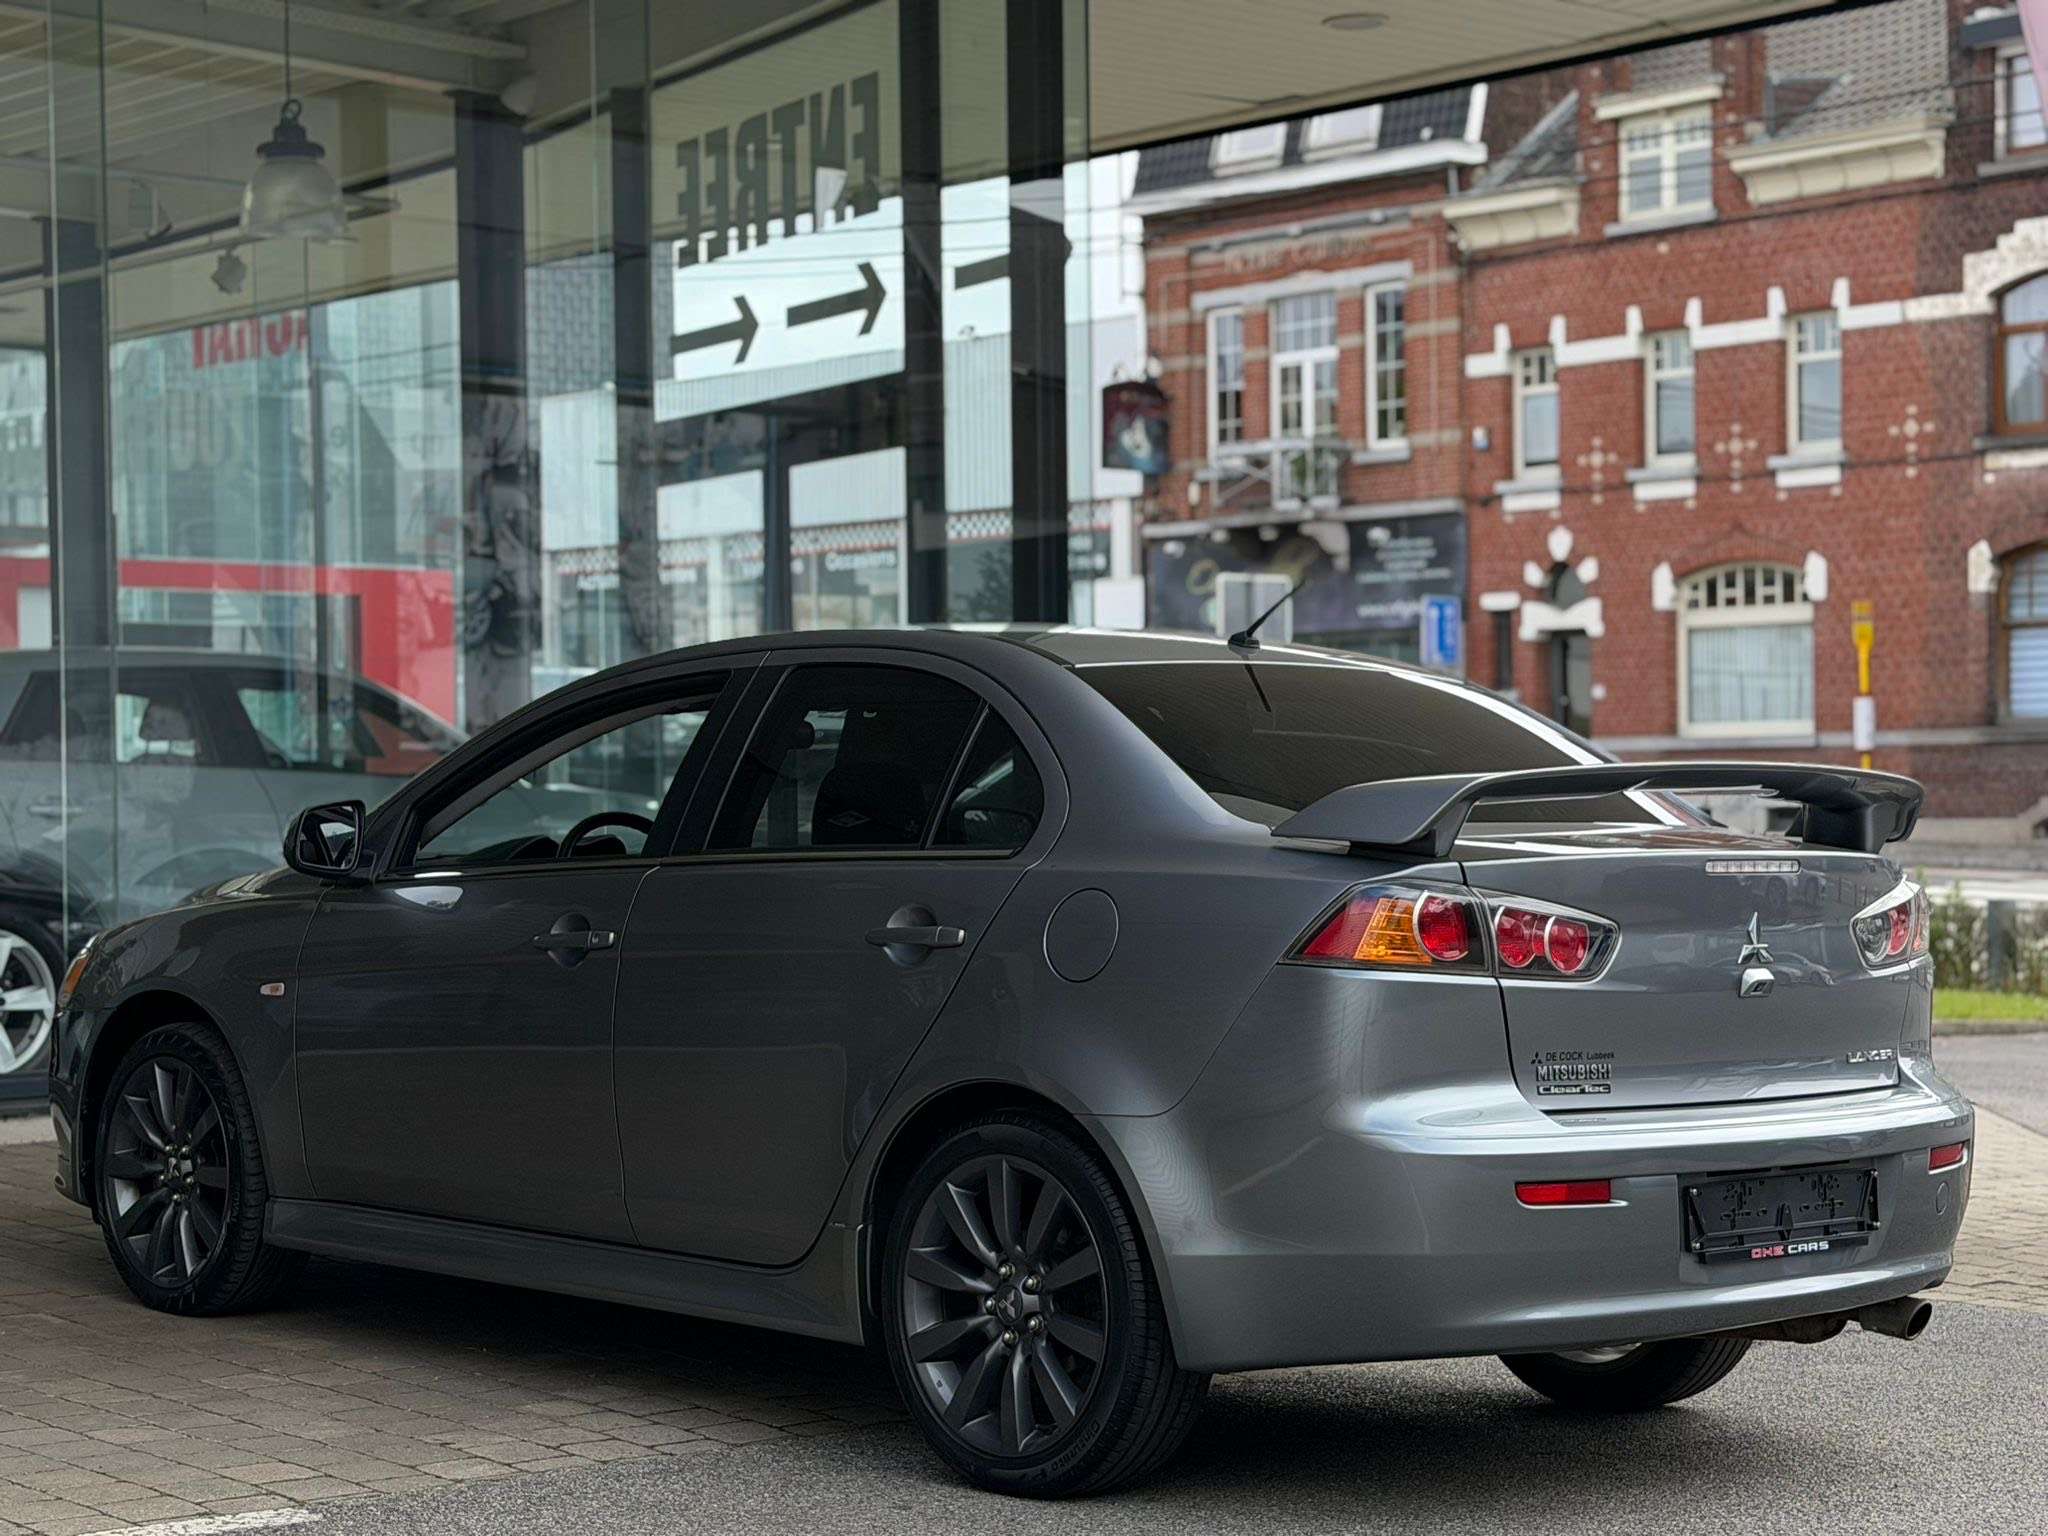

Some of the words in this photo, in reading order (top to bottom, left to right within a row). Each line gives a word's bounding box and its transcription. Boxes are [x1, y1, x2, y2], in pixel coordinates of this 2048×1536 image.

[1545, 1051, 1557, 1061] DE
[1559, 1051, 1583, 1061] COCK
[1536, 1063, 1612, 1081] MITSUBISHI
[1751, 1245, 1785, 1259] ONE
[1787, 1241, 1830, 1254] CARS
